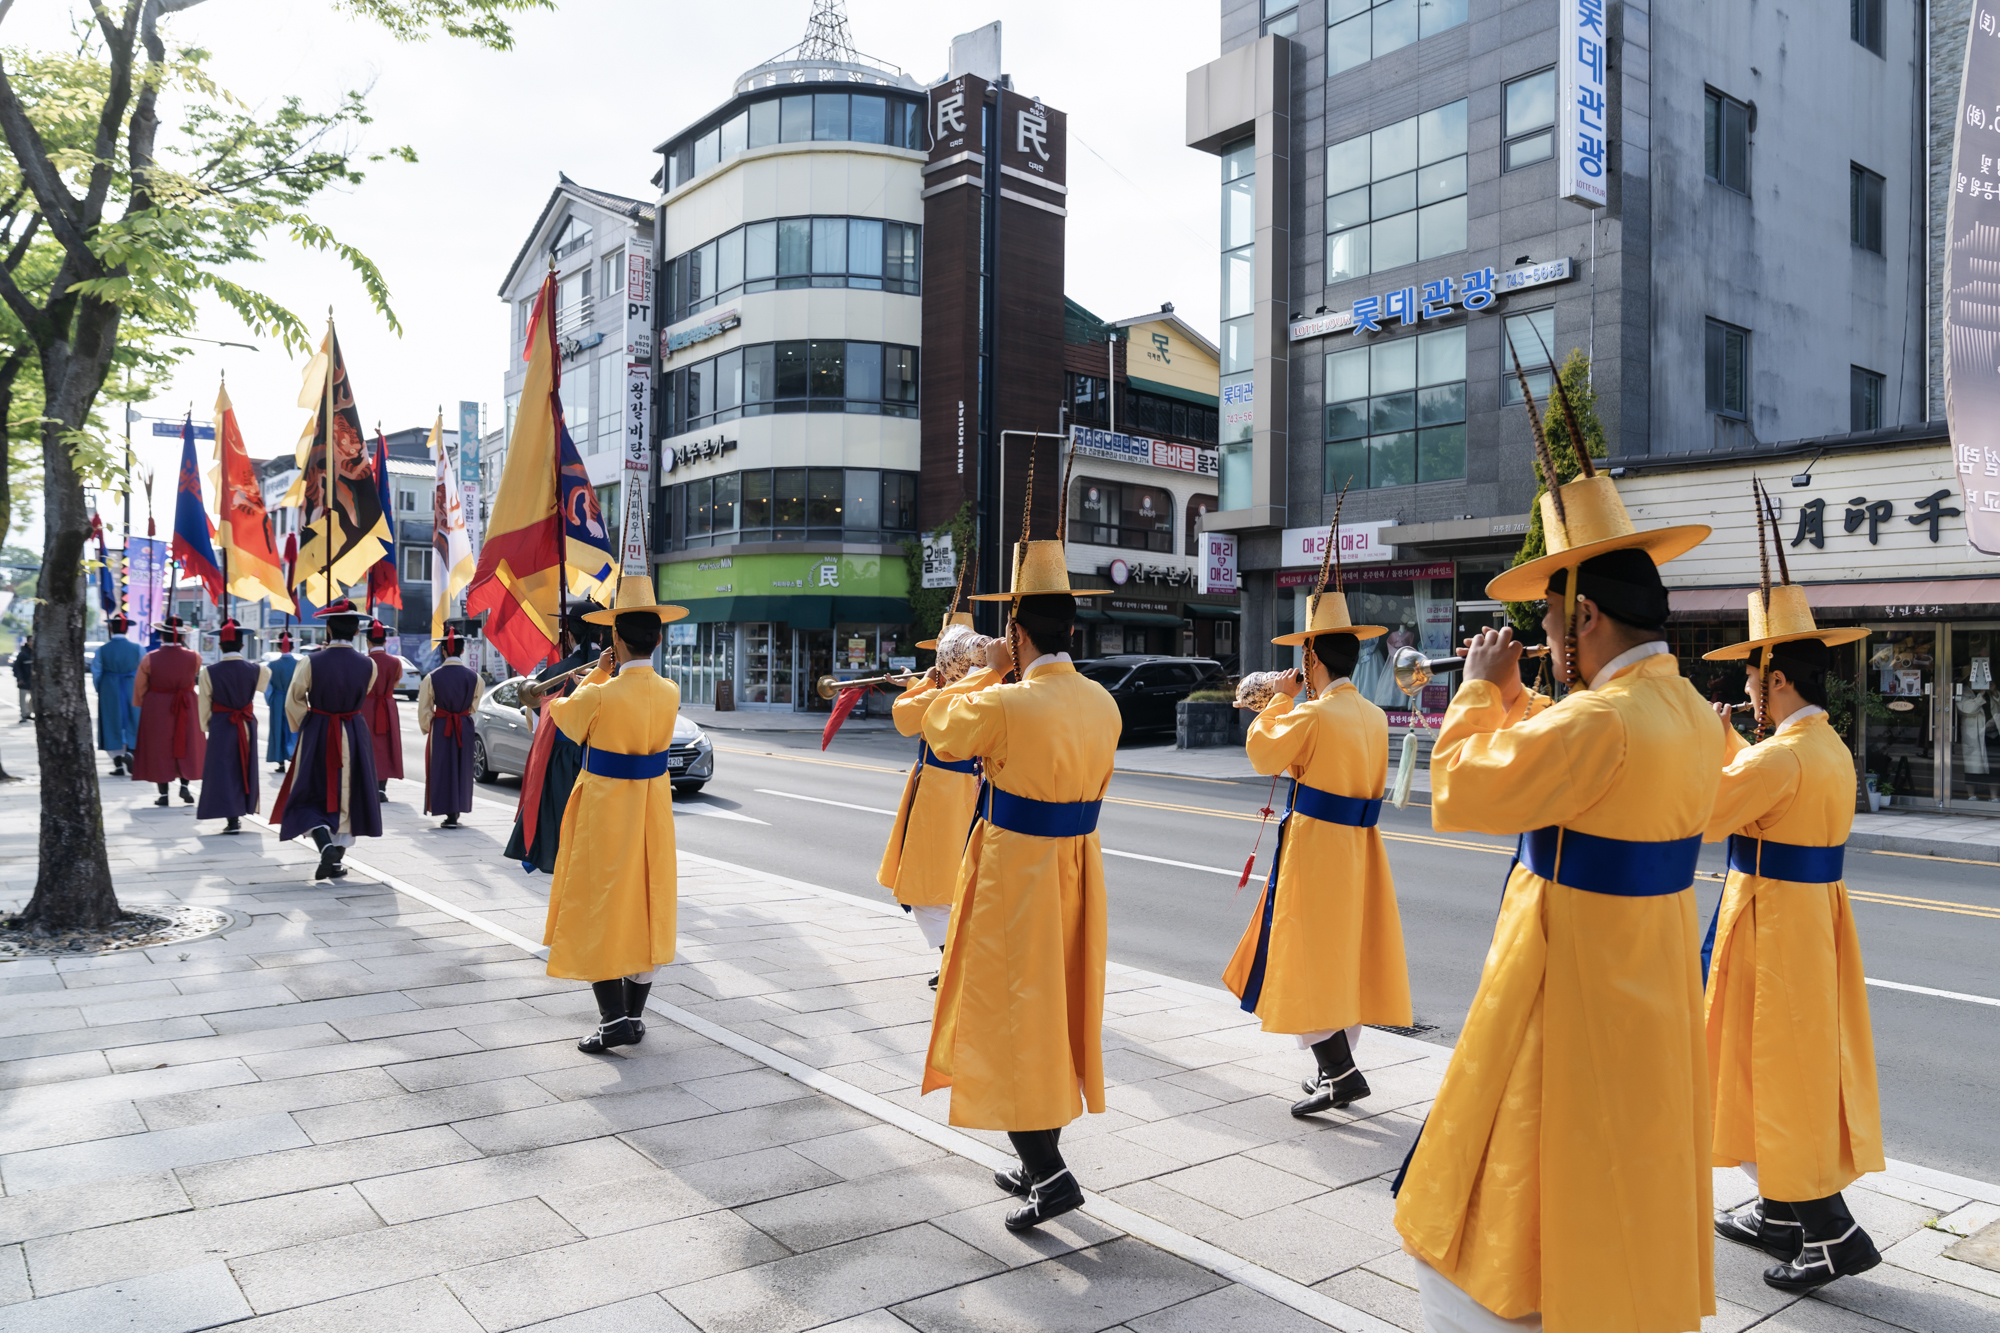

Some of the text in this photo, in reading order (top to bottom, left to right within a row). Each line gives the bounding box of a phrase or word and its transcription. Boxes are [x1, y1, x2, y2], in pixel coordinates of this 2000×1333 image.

[1577, 0, 1605, 177] 롯데관광
[937, 93, 967, 141] 民
[949, 138, 964, 147] 디자인
[1017, 110, 1050, 161] 民
[1028, 161, 1044, 173] 디자인
[1577, 180, 1606, 198] LOTTE TOUR
[629, 255, 644, 300] 올바른
[1505, 262, 1565, 289] 743-5665
[628, 303, 651, 322] PT
[1353, 267, 1499, 336] 롯데관광
[1294, 315, 1351, 337] LOTTE TOUR
[630, 382, 647, 460] 왕갈비탕
[676, 435, 724, 467] 진주본가
[1153, 442, 1195, 471] 올바른
[630, 489, 640, 543] 커피하우스
[1790, 488, 1961, 550] 月印千
[628, 544, 641, 560] 민
[1211, 541, 1233, 557] 매리
[1341, 533, 1368, 551] 매리
[720, 557, 732, 569] MIN
[824, 556, 838, 564] MIN
[796, 579, 803, 588] 민
[818, 564, 840, 588] 民
[1131, 562, 1197, 589] 진주본가
[1210, 567, 1233, 582] 매리
[1341, 571, 1359, 581] 복대여
